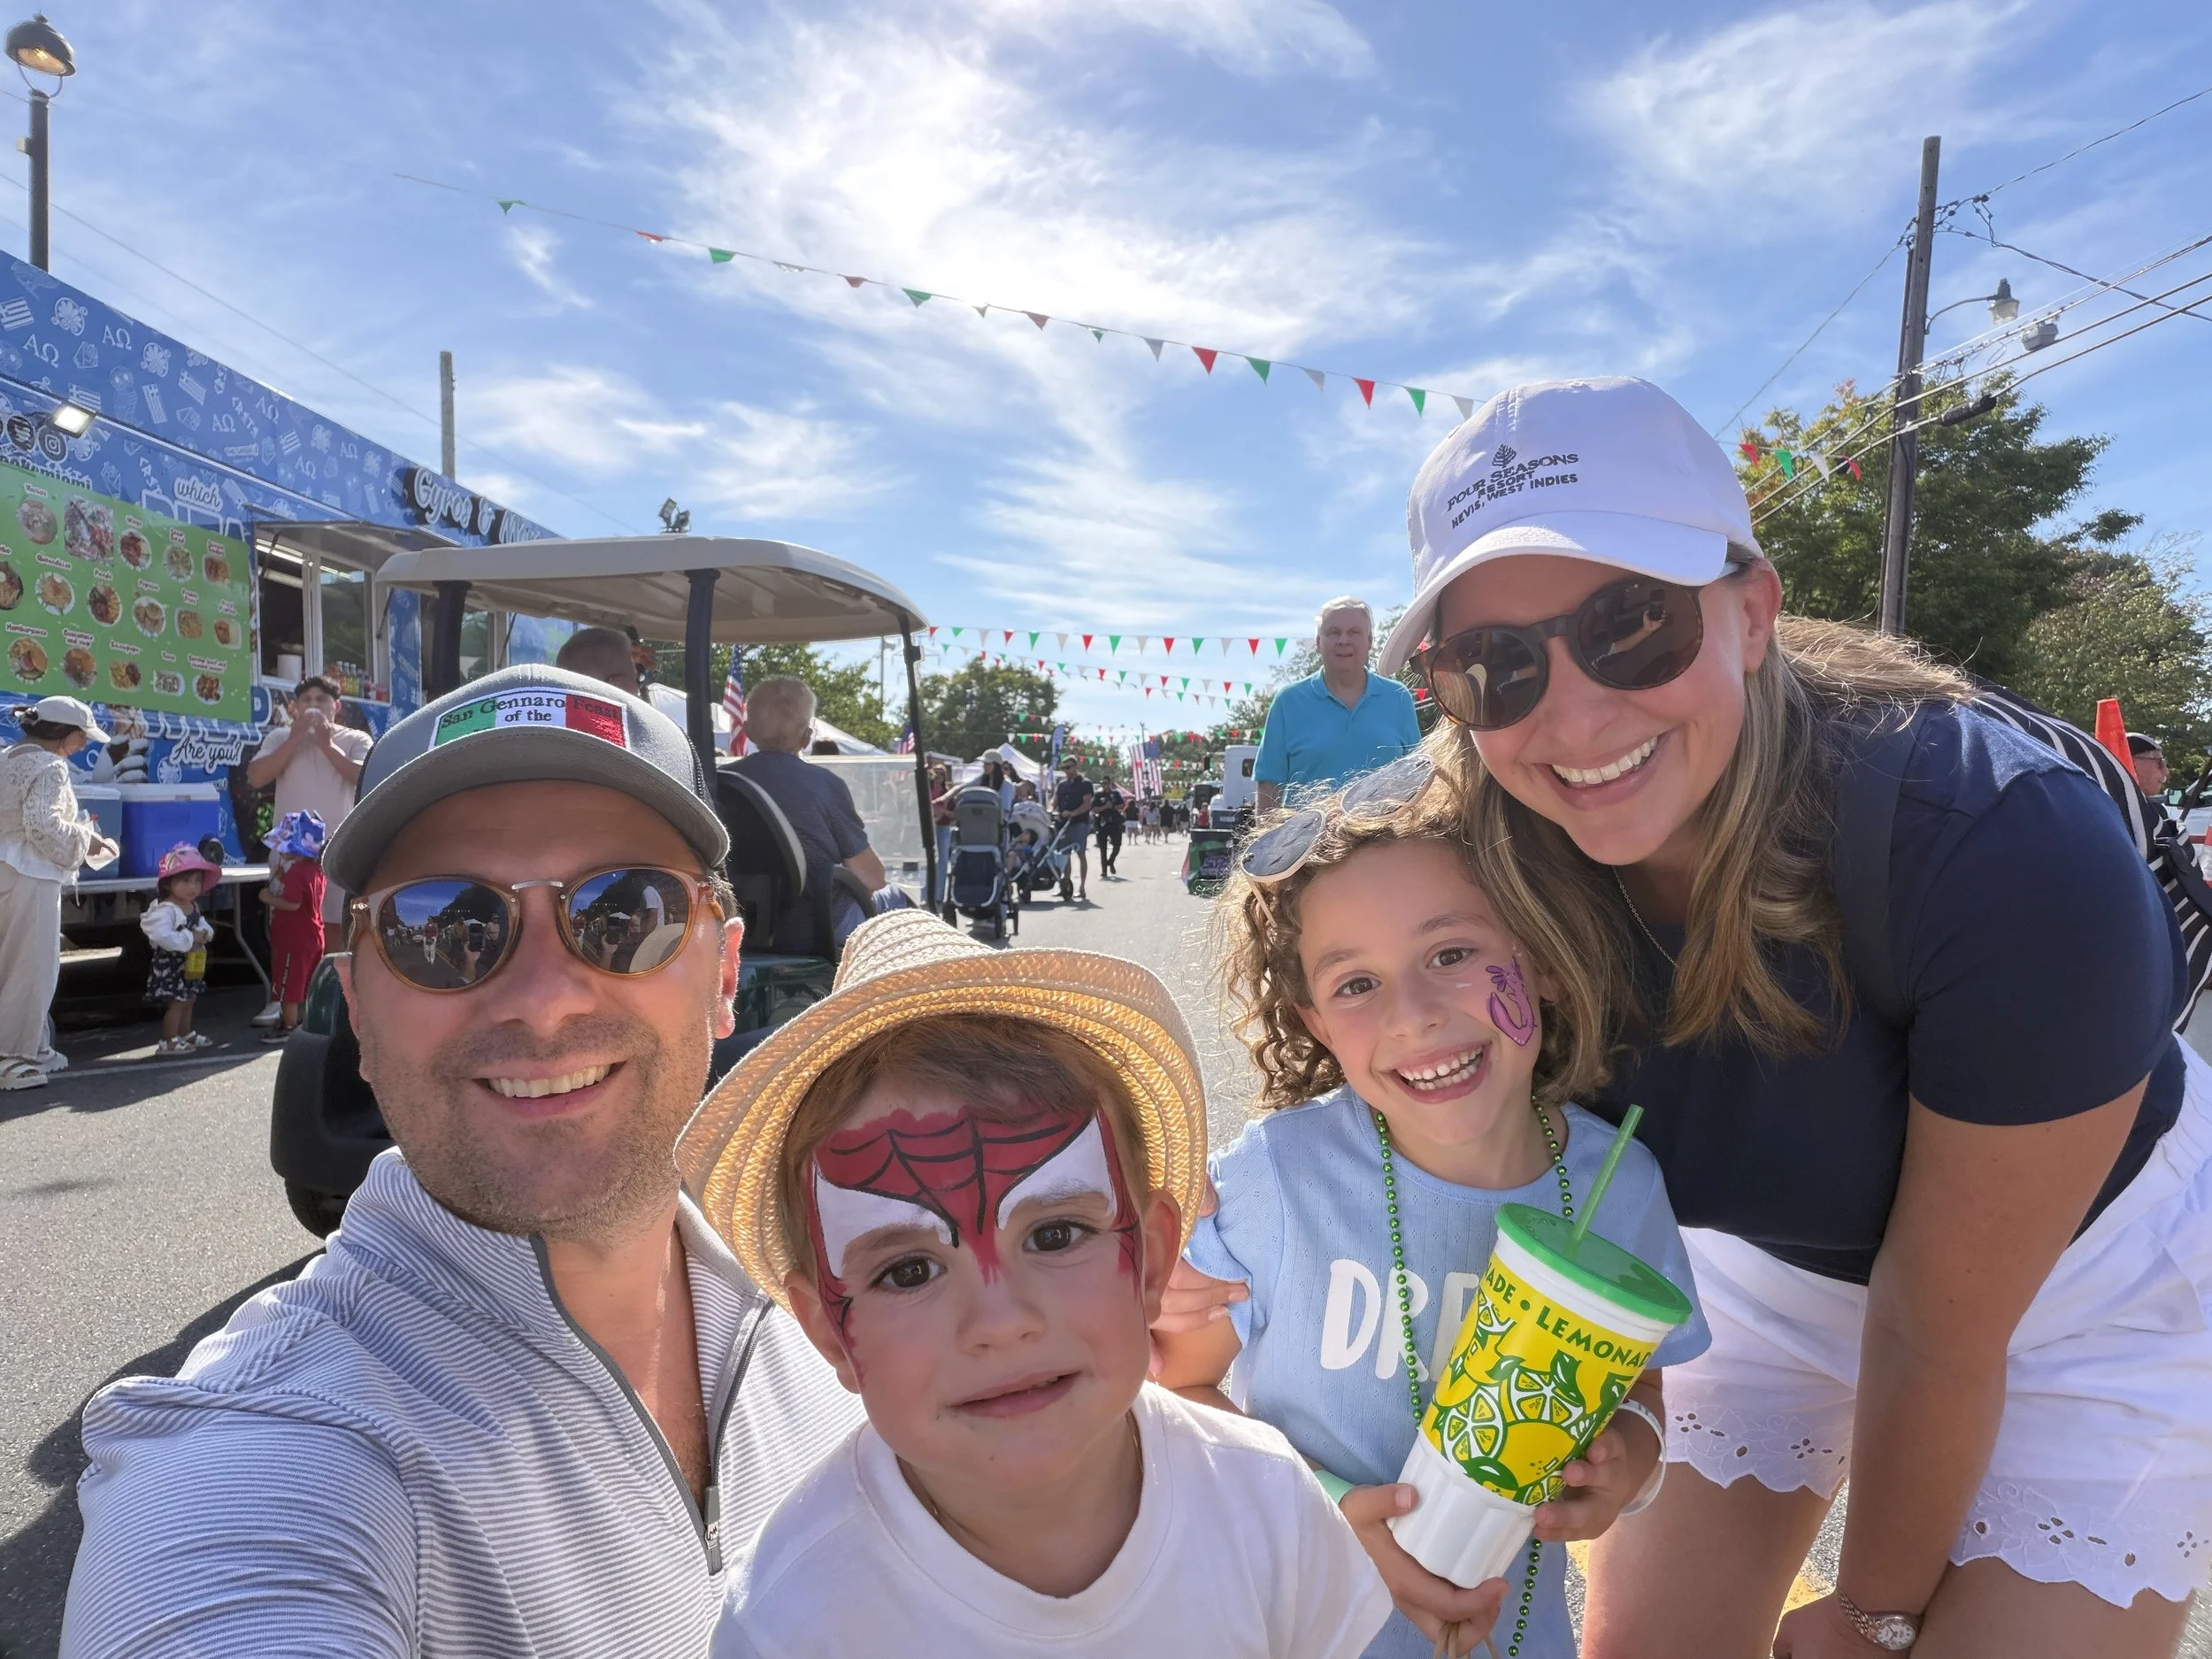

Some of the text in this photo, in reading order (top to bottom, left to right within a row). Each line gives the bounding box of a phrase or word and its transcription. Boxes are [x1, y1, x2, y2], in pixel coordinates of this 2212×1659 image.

[176, 478, 221, 509] which
[1447, 454, 1578, 511] FOUR SEASONS
[1478, 471, 1535, 498] RESORT
[414, 466, 472, 529] Gyros
[478, 496, 495, 536] &
[1451, 473, 1578, 529] NEVIS, WEST INDIES
[441, 696, 618, 728] San Gennaro Feast
[504, 710, 552, 722] of the
[173, 734, 205, 760] Are
[1486, 1263, 1517, 1305] ADE
